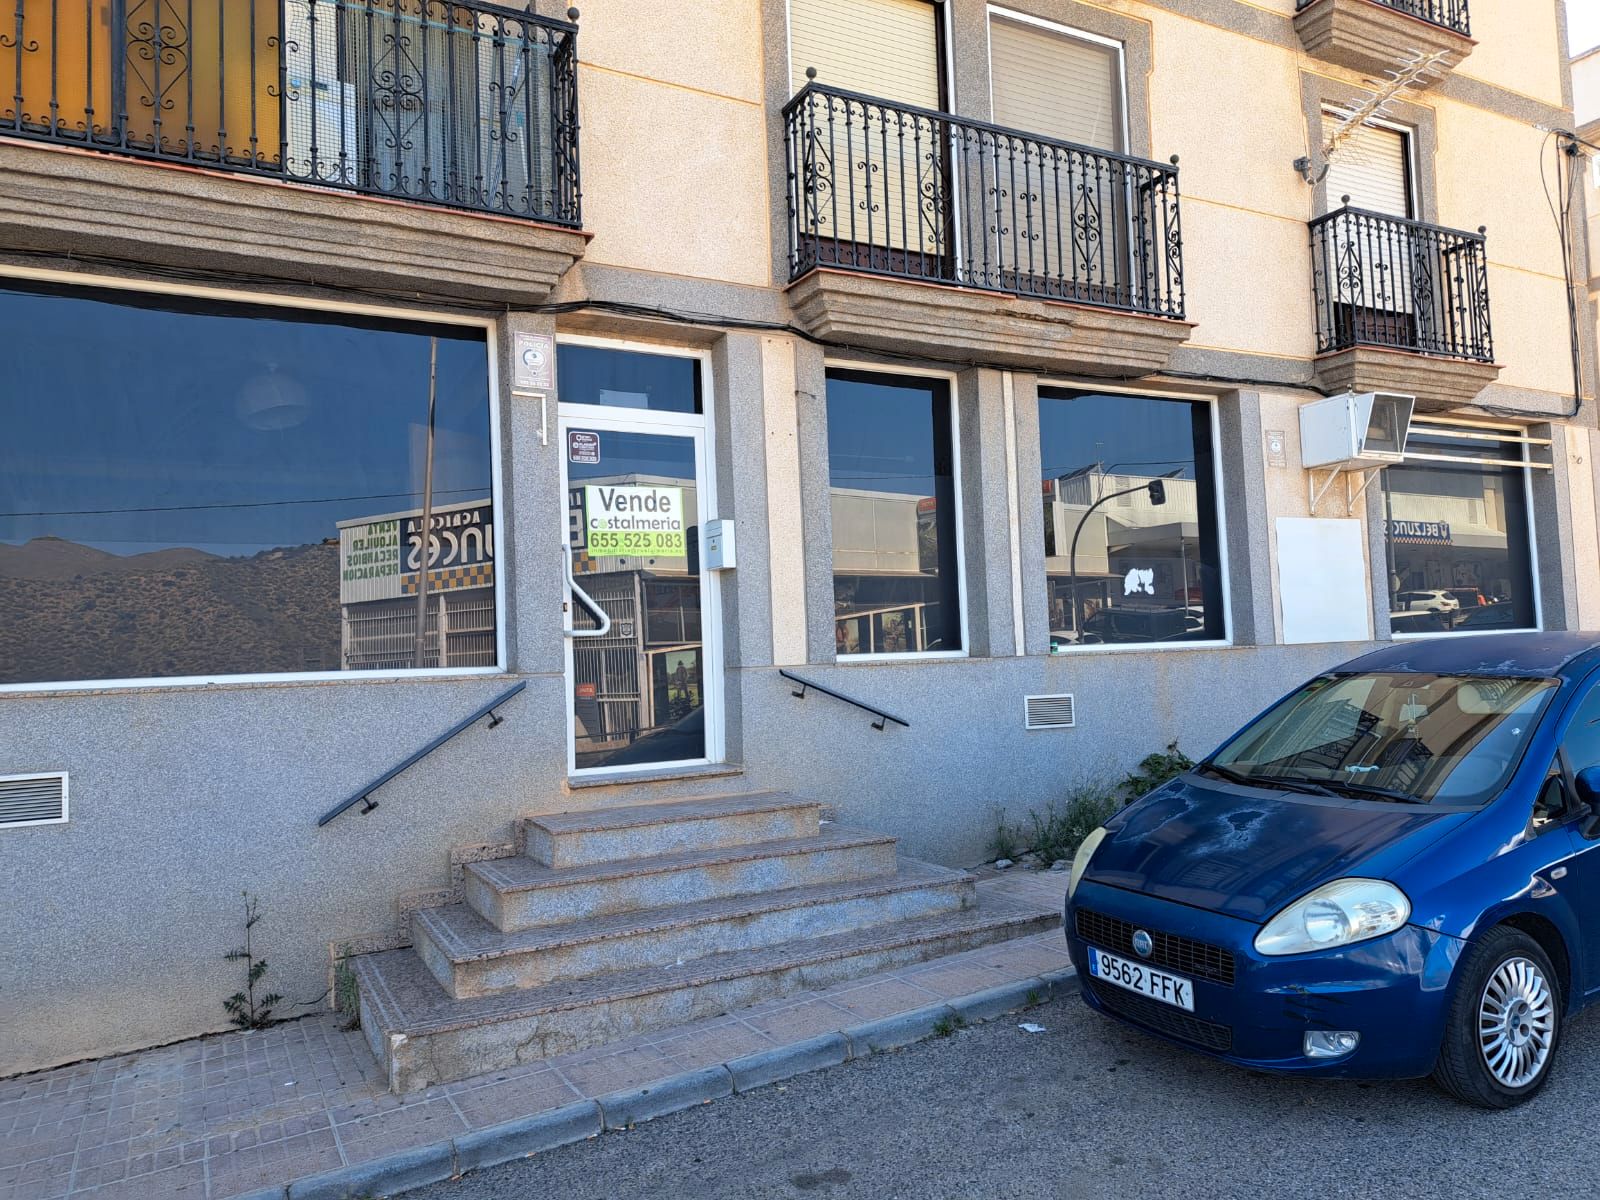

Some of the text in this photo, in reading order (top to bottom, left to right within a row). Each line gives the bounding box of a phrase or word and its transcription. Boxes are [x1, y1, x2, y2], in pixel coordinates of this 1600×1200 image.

[598, 487, 671, 513] Vende
[590, 532, 682, 548] 655 525 083
[1101, 954, 1185, 1006] 9562 FFK
